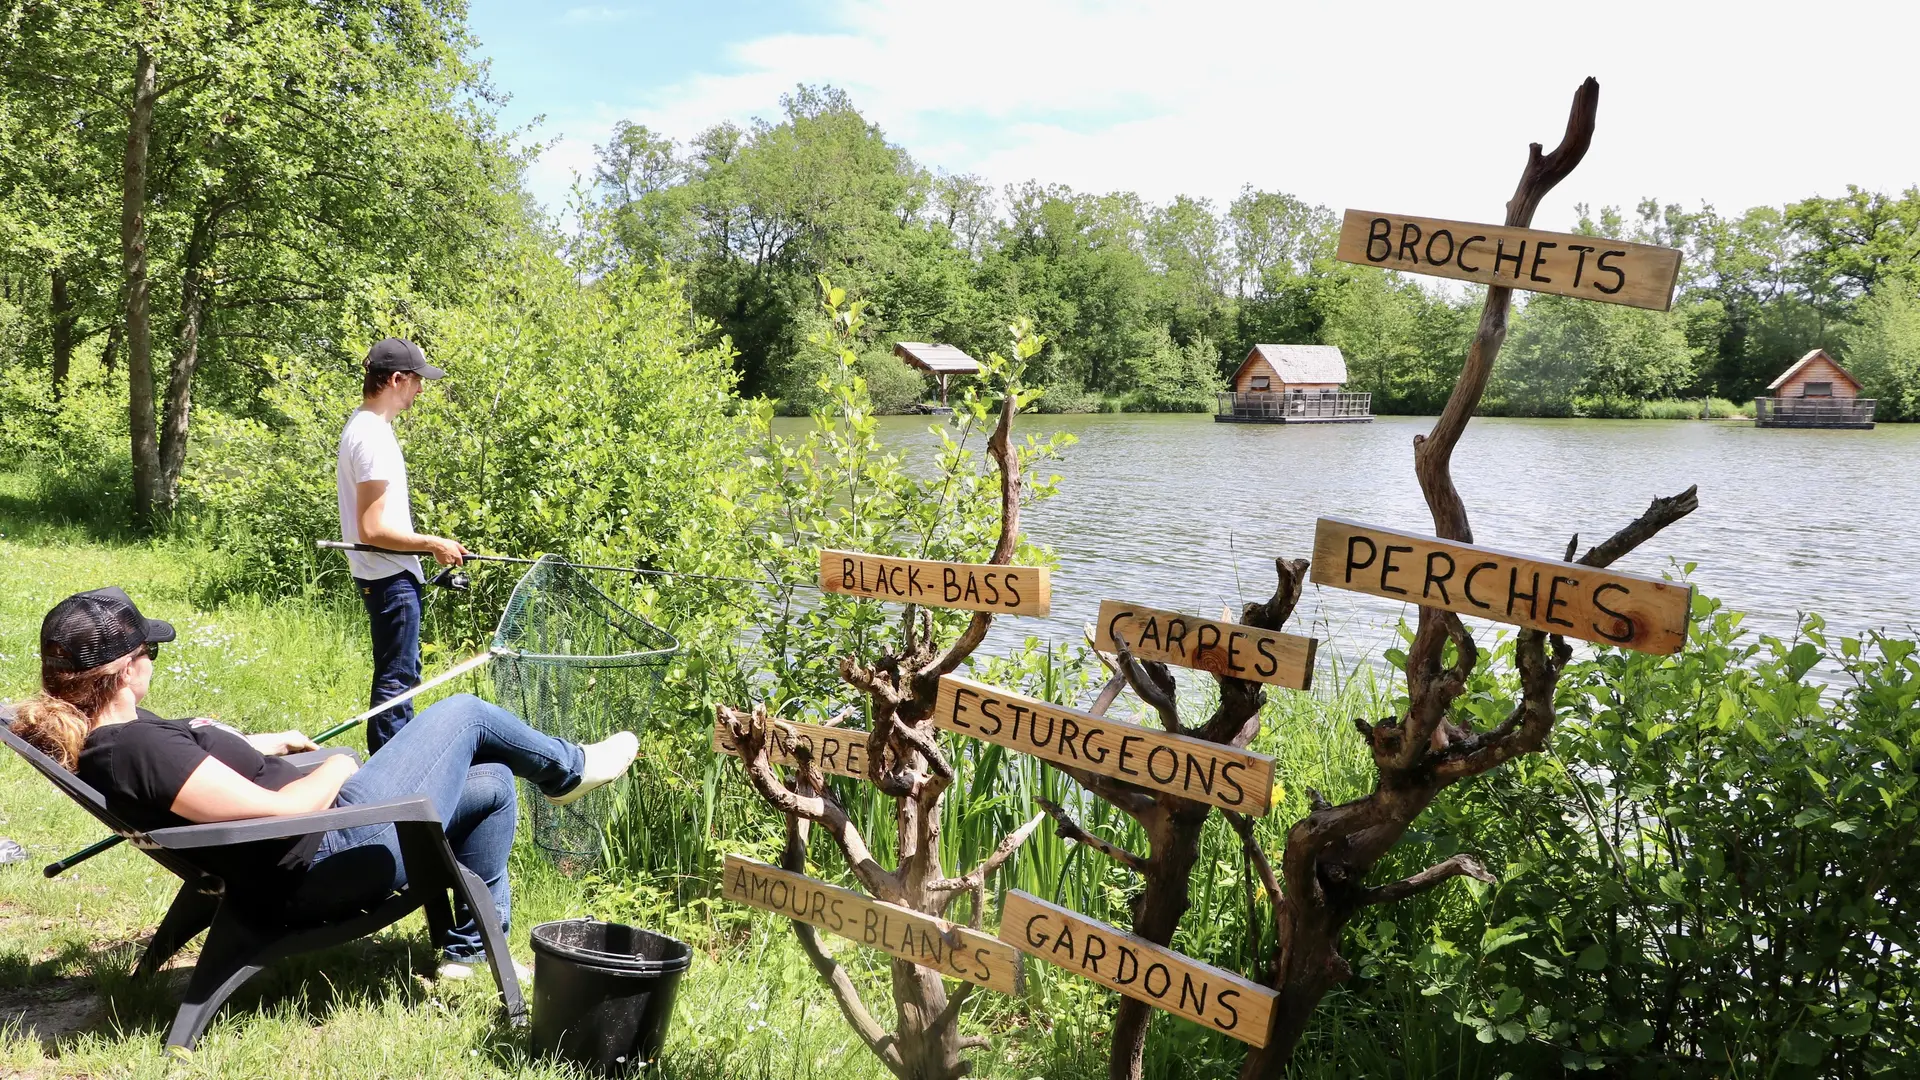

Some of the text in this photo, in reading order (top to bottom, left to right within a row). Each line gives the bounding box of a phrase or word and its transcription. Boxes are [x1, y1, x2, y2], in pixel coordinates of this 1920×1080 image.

[1365, 217, 1627, 294] BROCHETS
[841, 558, 1021, 608] BLACK-BASS
[1345, 535, 1636, 643] PERCHES
[1109, 611, 1278, 677] CARPES
[951, 687, 1246, 805] ESTURGEONS
[732, 865, 991, 982] AMOURS-BLANCS
[1025, 914, 1241, 1030] GARDONS
